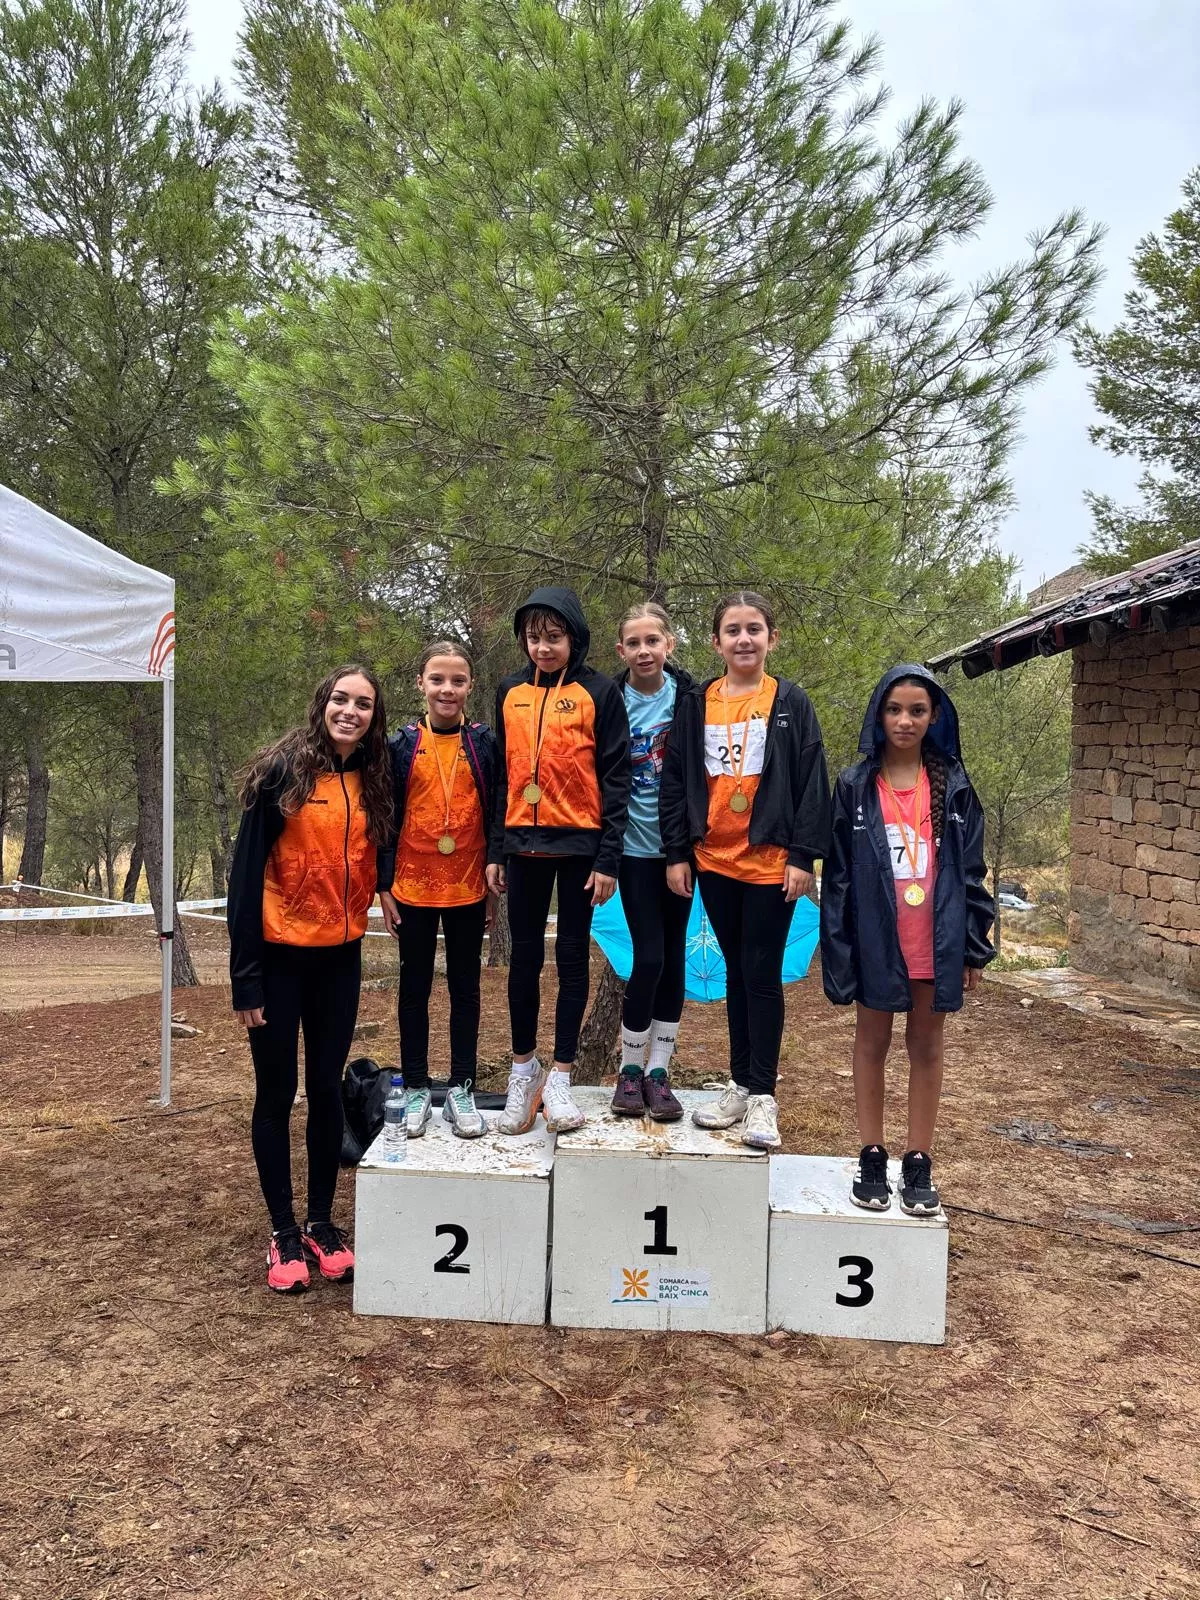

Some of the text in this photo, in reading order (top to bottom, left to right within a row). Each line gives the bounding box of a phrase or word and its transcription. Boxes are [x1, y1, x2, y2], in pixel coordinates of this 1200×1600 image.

[718, 744, 742, 764] 23
[643, 1205, 678, 1256] 1
[433, 1223, 471, 1274] 2
[659, 1292, 679, 1300] BAIX
[681, 1289, 709, 1297] CINCA
[835, 1255, 874, 1308] 3
